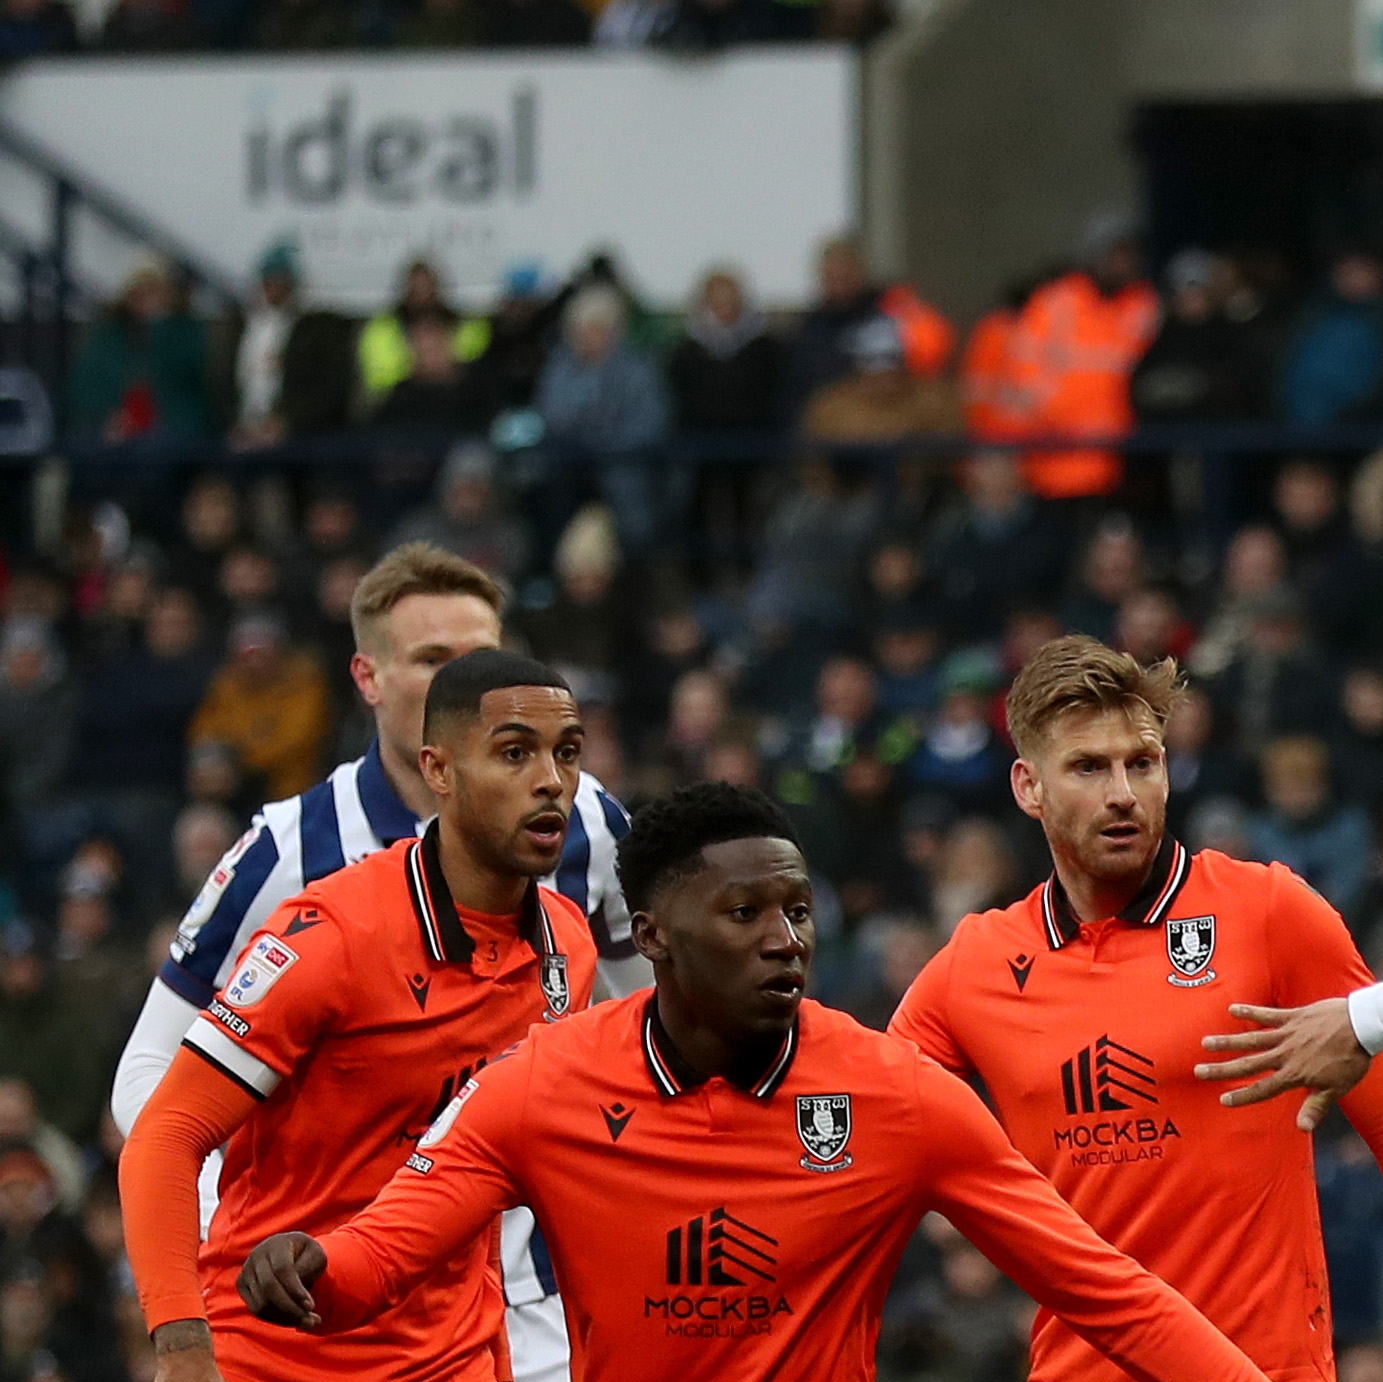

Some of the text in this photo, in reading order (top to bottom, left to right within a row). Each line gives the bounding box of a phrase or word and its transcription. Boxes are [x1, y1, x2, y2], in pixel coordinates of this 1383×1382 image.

[246, 88, 538, 207] ideal
[486, 941, 499, 962] 3
[1053, 1118, 1182, 1150] MOCKBA
[1071, 1146, 1163, 1167] MODULAR
[644, 1294, 793, 1320] MOCKBA
[665, 1321, 772, 1338] MODULAR
